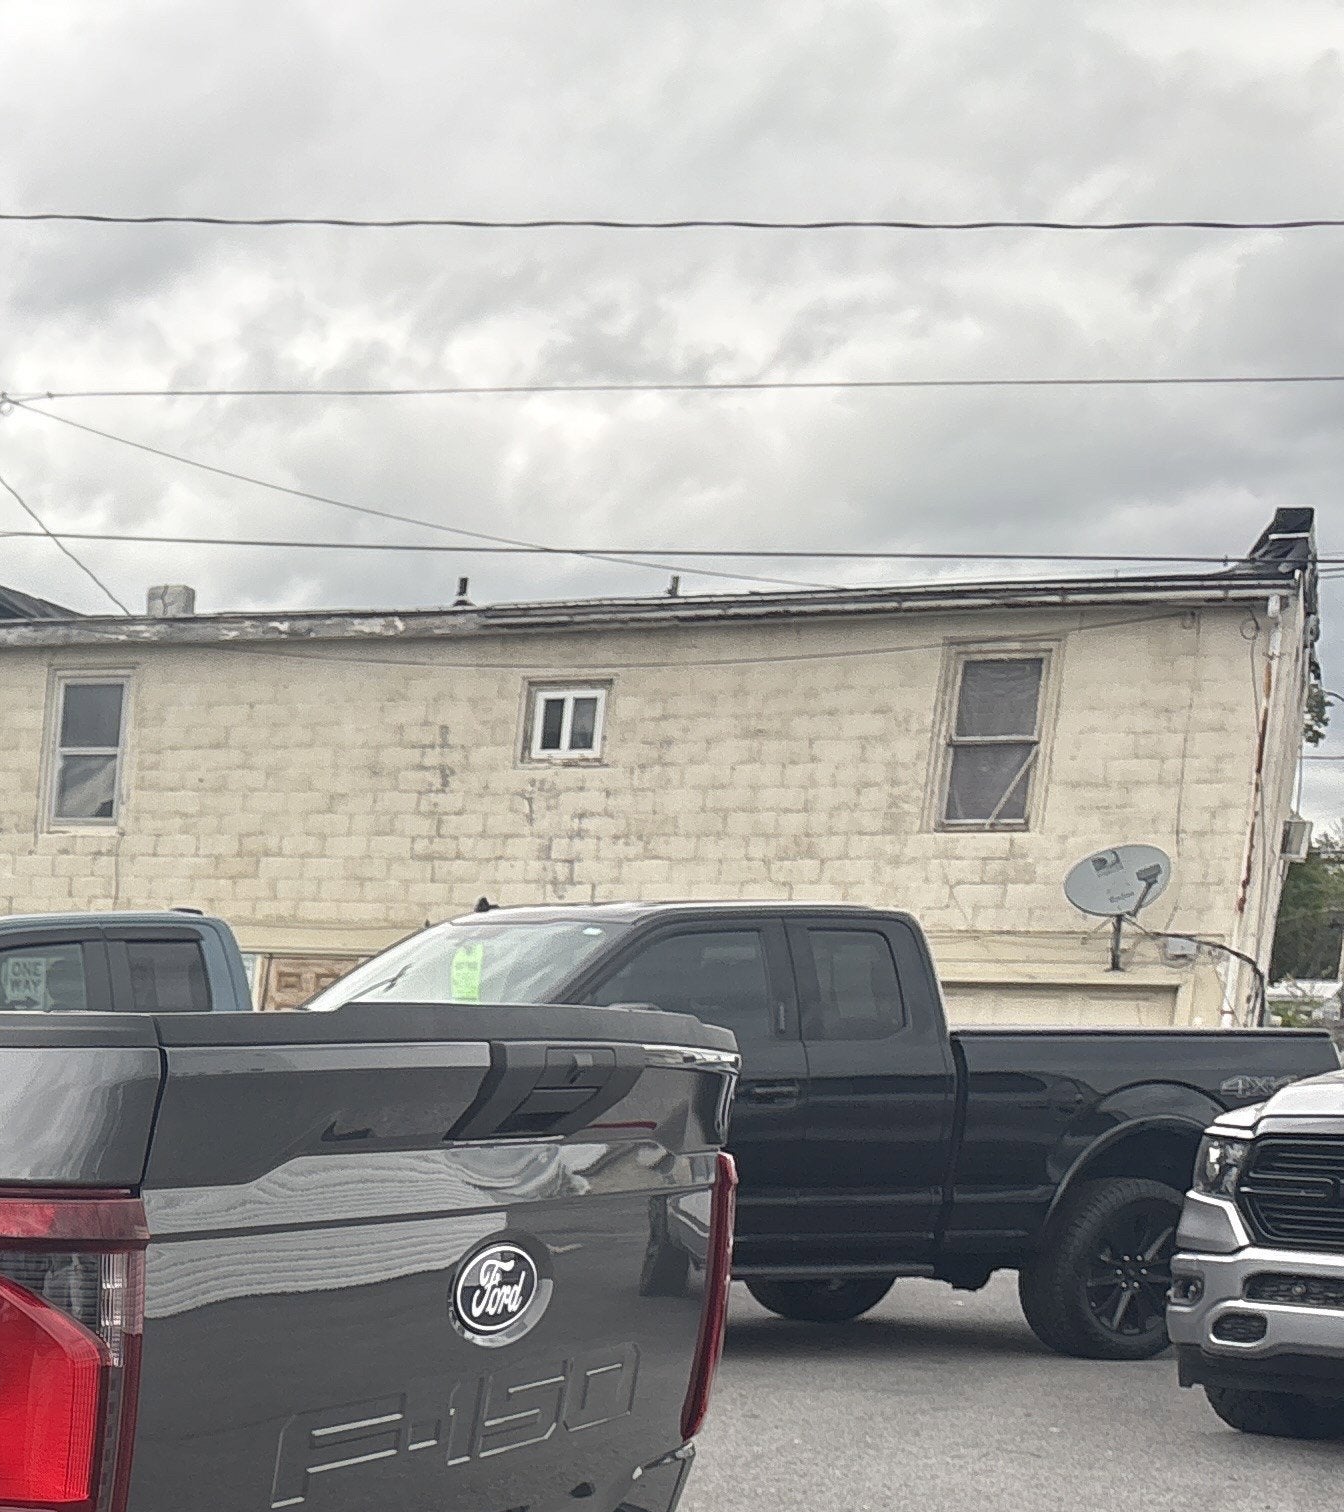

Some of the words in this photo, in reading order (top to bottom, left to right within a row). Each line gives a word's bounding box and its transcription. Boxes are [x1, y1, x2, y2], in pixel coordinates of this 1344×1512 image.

[12, 961, 43, 977] ONE
[12, 979, 42, 995] WAY
[471, 1259, 526, 1318] Ford
[270, 1340, 641, 1509] F-150
